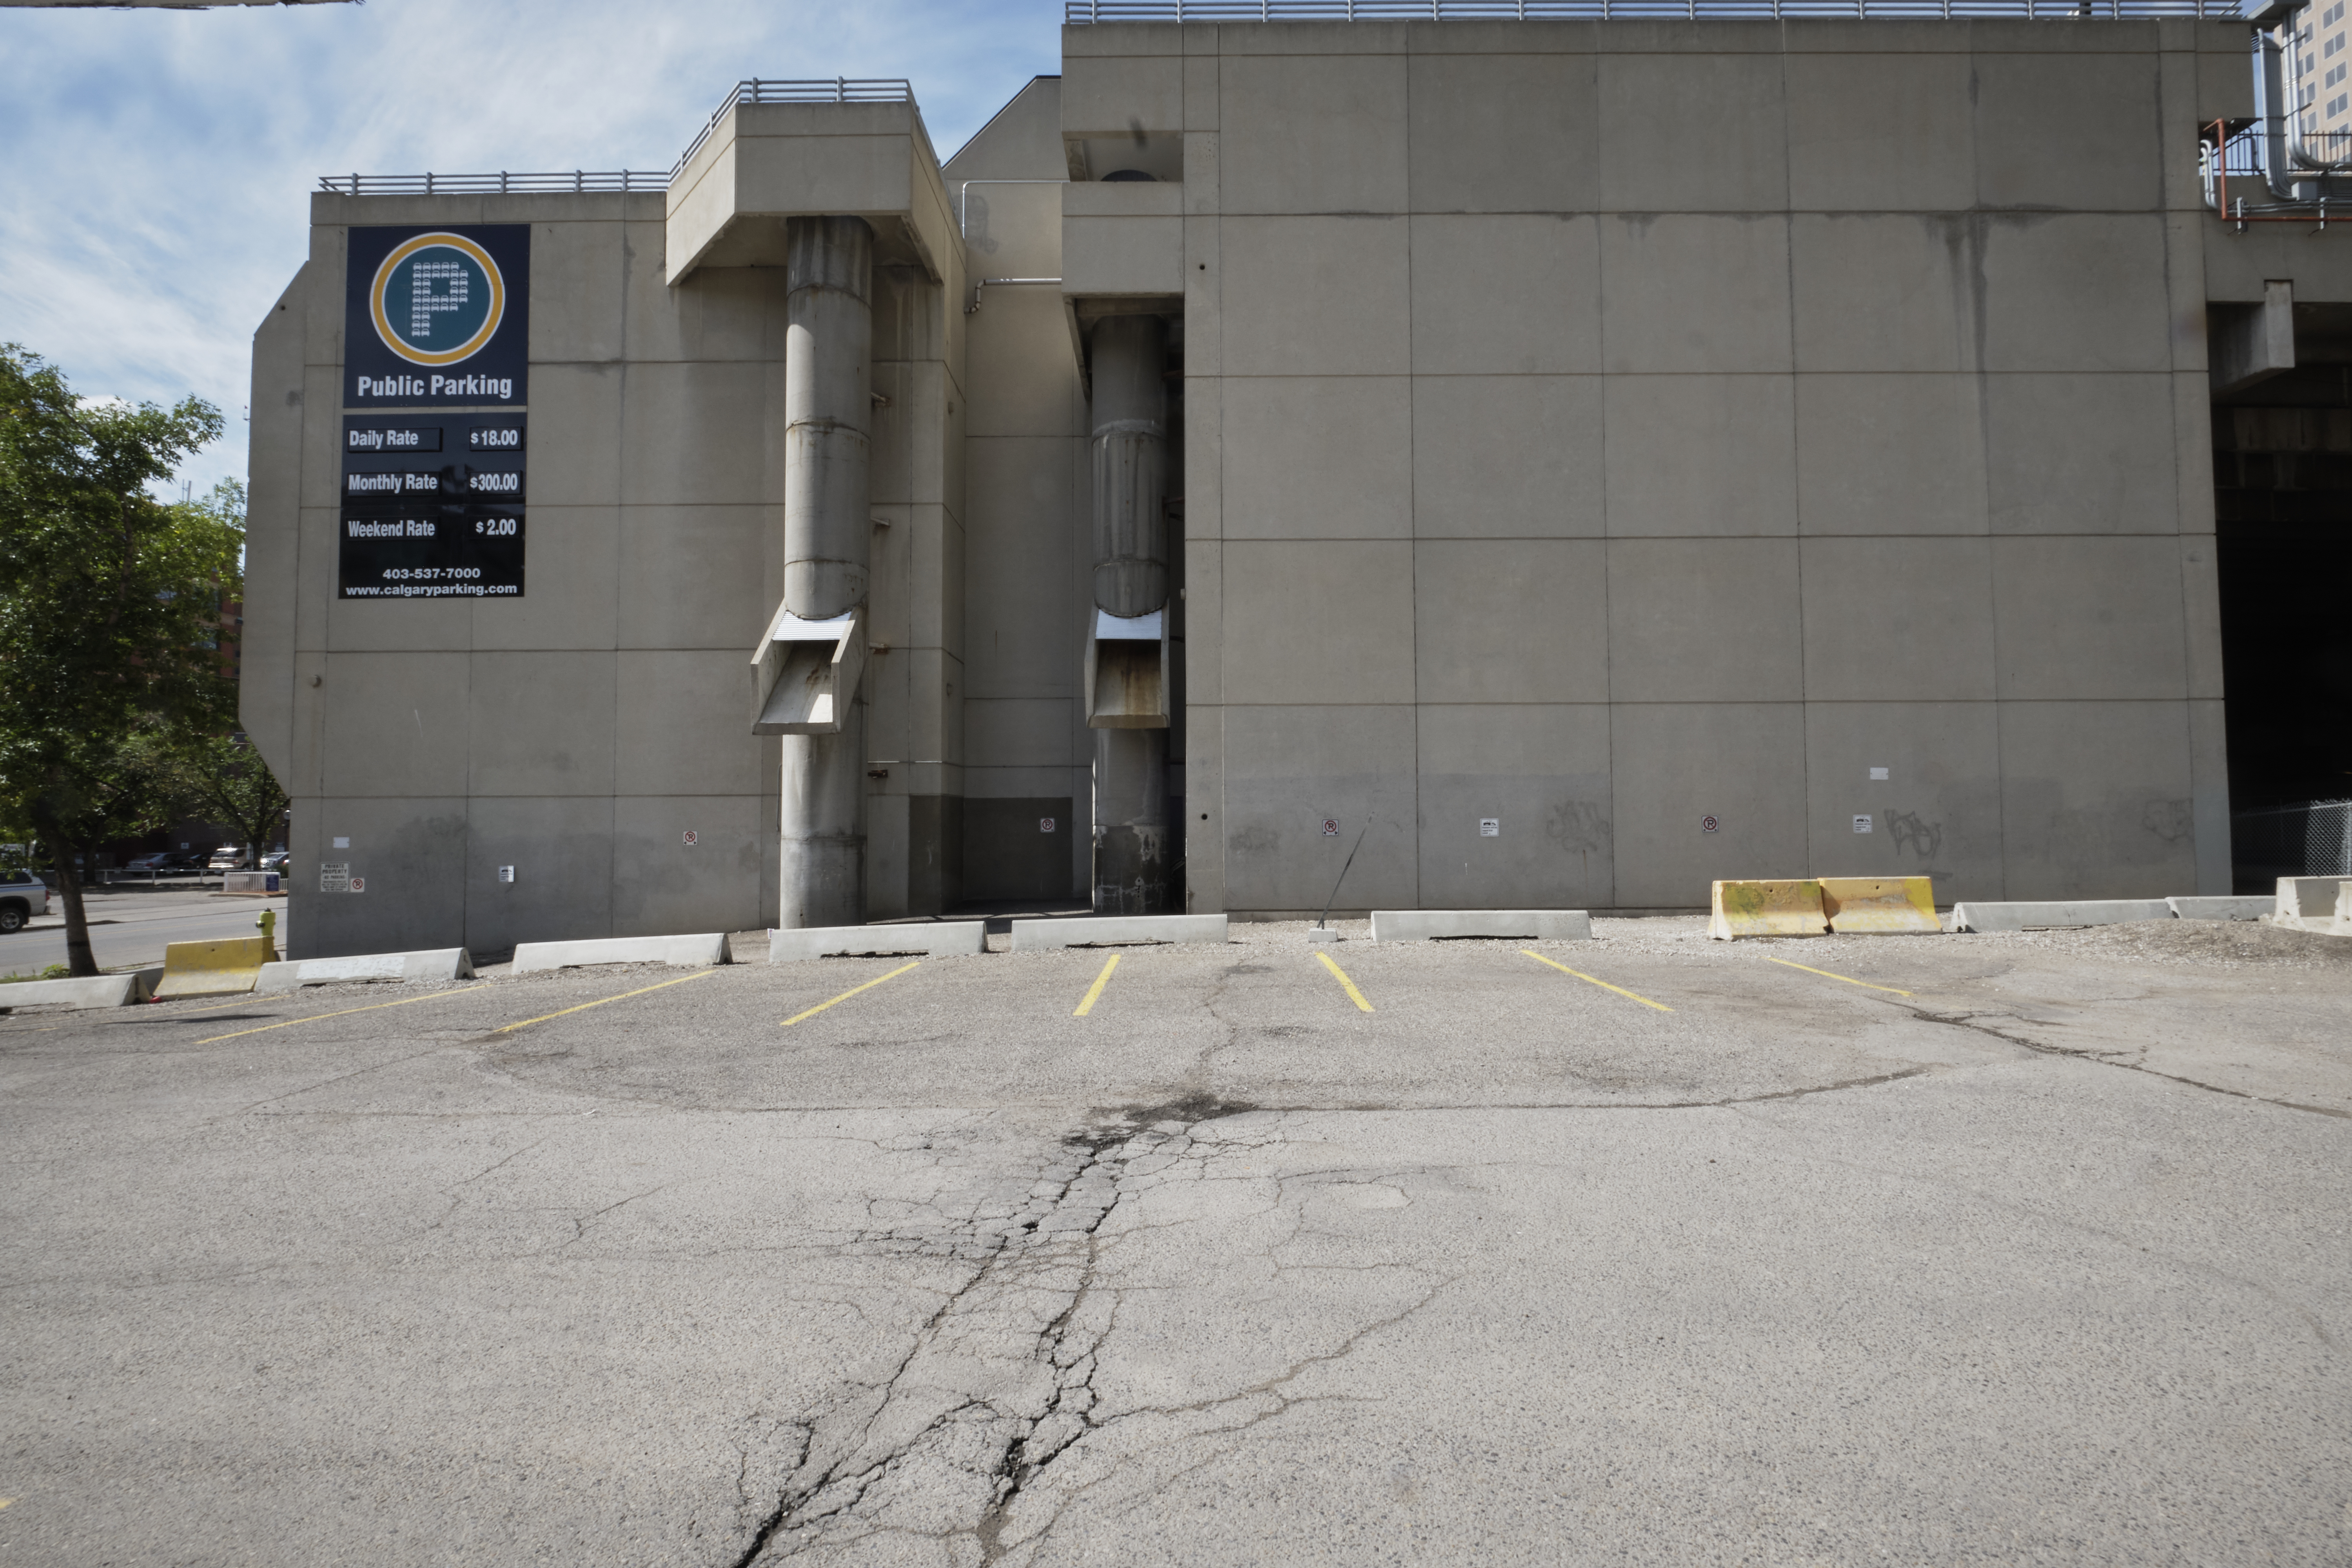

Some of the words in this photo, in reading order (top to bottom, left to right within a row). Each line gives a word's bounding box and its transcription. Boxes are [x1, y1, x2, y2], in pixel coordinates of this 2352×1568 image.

[358, 375, 424, 396] Public
[431, 374, 512, 399] Parking
[349, 430, 383, 449] Daily
[387, 430, 419, 445] Rate
[348, 474, 403, 494] Monthly
[406, 474, 438, 490] Rate
[470, 473, 518, 491] $300.00
[348, 520, 403, 537] Weekend
[407, 520, 435, 536] Rate
[383, 568, 481, 579] 403-537-7000
[346, 583, 517, 597] www.calgaryparking.com
